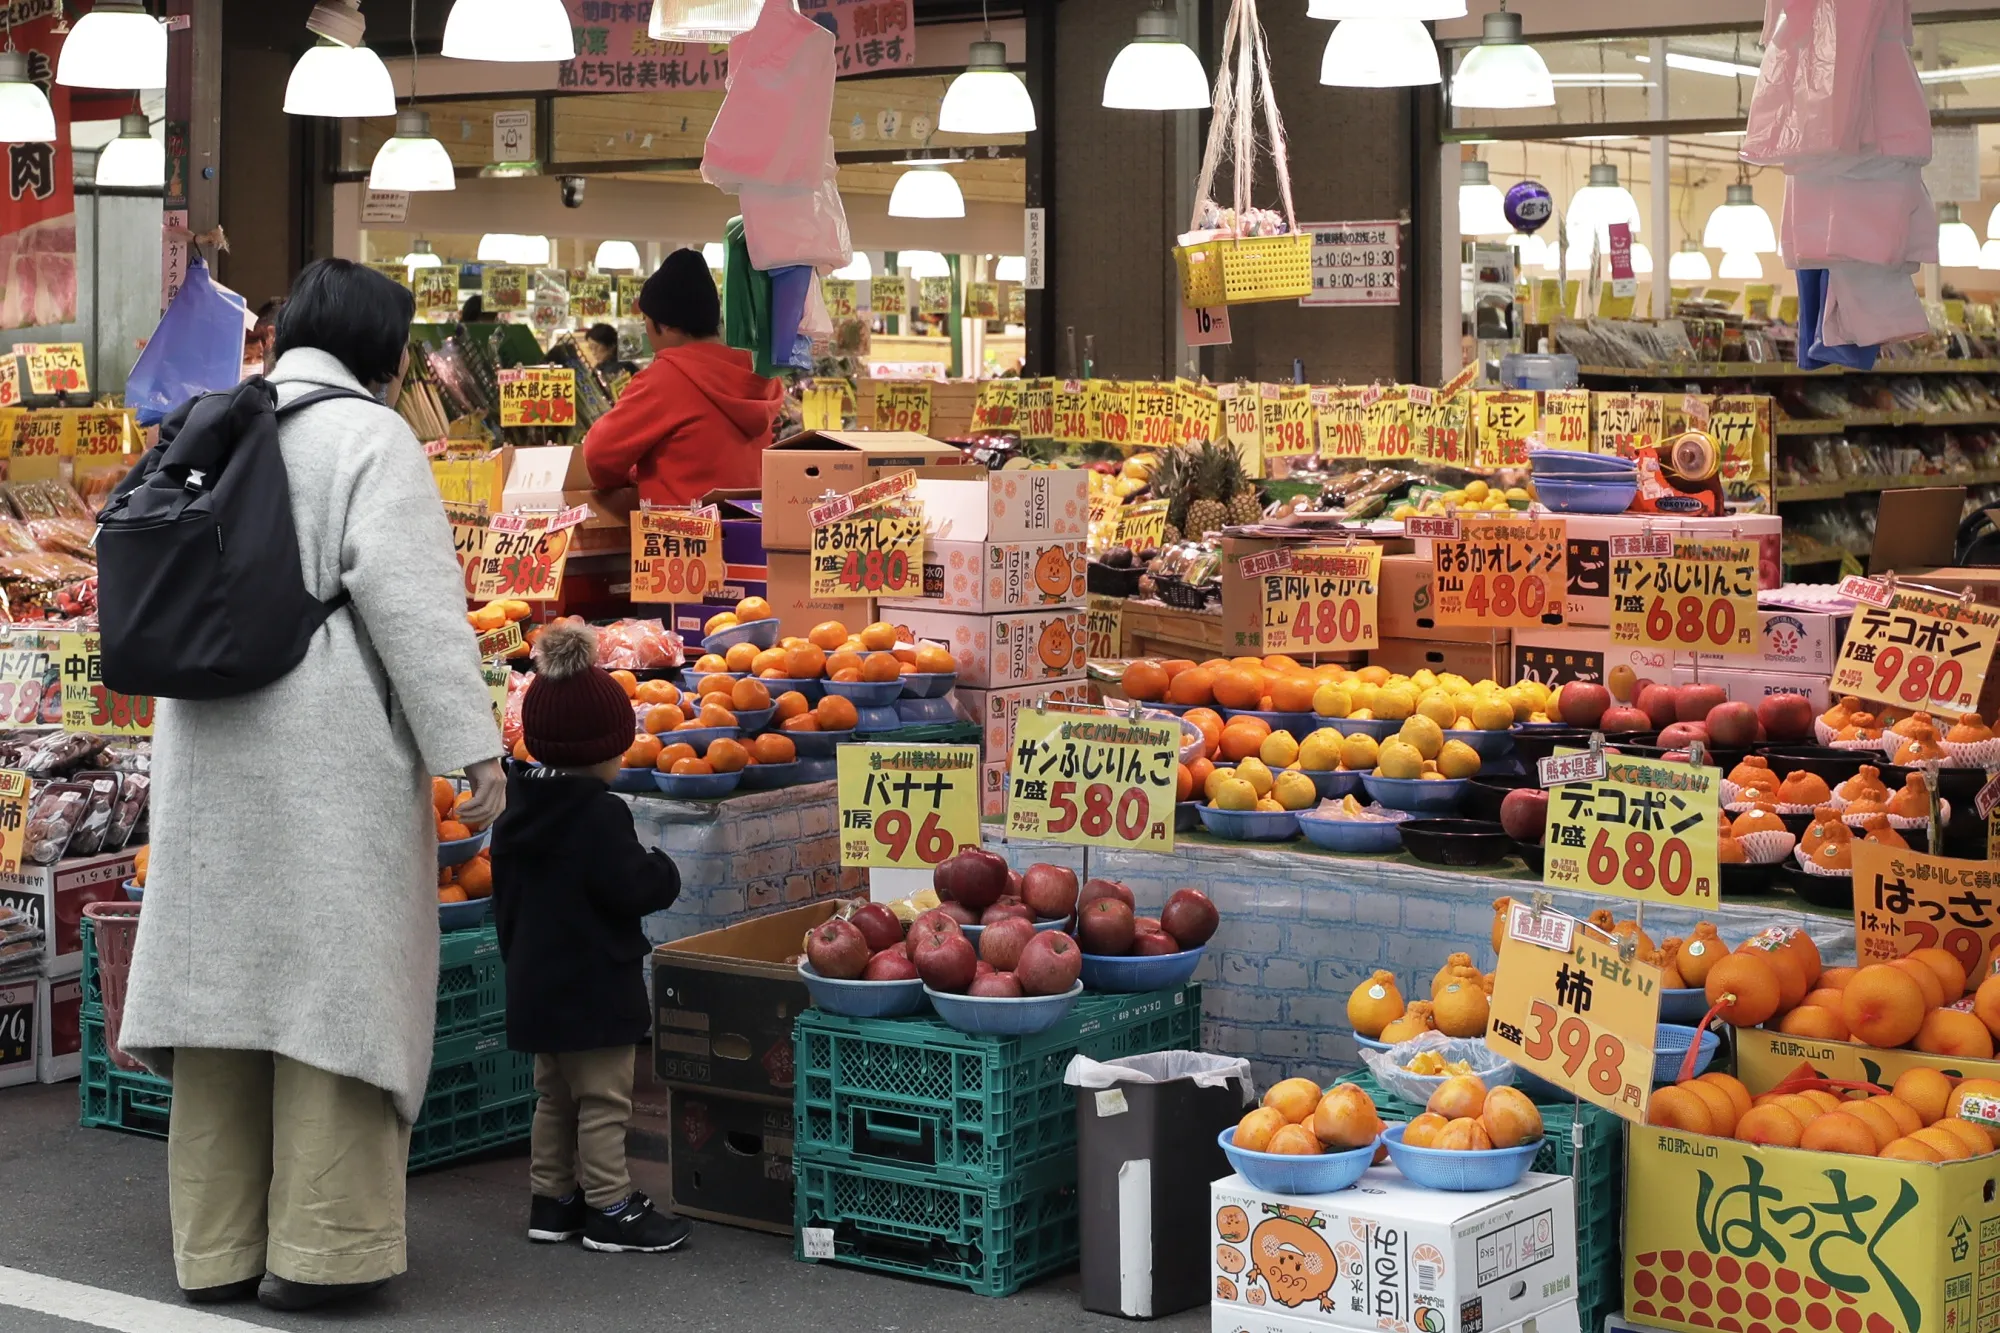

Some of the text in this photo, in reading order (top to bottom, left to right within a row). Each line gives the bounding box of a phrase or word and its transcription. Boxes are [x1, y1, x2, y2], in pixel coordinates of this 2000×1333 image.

[1030, 212, 1039, 286] 防犯カメラ設置店
[1315, 230, 1387, 245] 営業時間のお知らせ
[424, 288, 452, 308] 150
[1195, 308, 1212, 334] 16
[31, 354, 82, 369] だいこん
[503, 381, 573, 400] 桃太郎とまと
[1055, 394, 1088, 412] デコポン
[1091, 392, 1130, 415] サンふじりんご
[1136, 395, 1174, 417] 土佐文旦
[1229, 396, 1256, 413] ライム
[1264, 401, 1310, 424] 完熟パイン
[1368, 402, 1416, 426] キウイフルーツ
[1487, 406, 1526, 428] レモン
[1601, 410, 1662, 434] プレミアムバナナ
[812, 500, 849, 523] 愛媛県産
[1657, 500, 1702, 511] YOKOYAMA
[813, 520, 922, 551] はるみオレンジ
[1115, 515, 1165, 541] 青パパイヤ
[1410, 519, 1455, 537] 熊本県産
[494, 531, 550, 555] みかん
[643, 532, 707, 558] 富有柿
[1613, 536, 1669, 555] 青森県産
[481, 557, 500, 574] 1盛
[634, 559, 651, 574] 1山
[814, 555, 838, 572] 1盛
[1023, 550, 1031, 580] 清水の
[1243, 551, 1290, 575] 愛知県産
[1436, 543, 1563, 574] はるかオレンジ
[1008, 550, 1020, 604] はるみ
[1438, 575, 1465, 593] 1山
[1613, 559, 1755, 598] サンふじりんご
[1614, 594, 1645, 613] 1盛
[1842, 579, 1889, 604] 熊本県産
[1265, 607, 1289, 627] 1山
[1614, 632, 1640, 642] アキダイ
[1861, 608, 1982, 658] デコポン
[1013, 625, 1025, 679] はるみ
[1844, 640, 1879, 664] 1盛
[1835, 677, 1862, 690] アキダイ
[65, 683, 155, 729] 1パック 380
[1017, 739, 1175, 787] サンふじりんご
[1545, 756, 1599, 781] 熊本県産
[862, 771, 954, 810] バナナ
[1014, 778, 1048, 801] 1盛
[843, 808, 873, 829] 1房
[1560, 782, 1705, 836] デコポン
[1011, 822, 1040, 833] アキダイ
[1550, 822, 1587, 849] 1盛
[845, 851, 870, 861] アキダイ
[1549, 869, 1580, 884] アキダイ
[1874, 873, 2000, 929] はっさ
[1517, 911, 1567, 945] 福島県産
[1860, 910, 1902, 937] 1ネット
[1554, 962, 1594, 1015] 柿
[1492, 1017, 1524, 1047] 1盛
[1770, 1039, 1836, 1061] 和歌山の
[1658, 1135, 1719, 1160] 和歌山の
[1479, 1246, 1495, 1259] 5kg
[1696, 1155, 1923, 1333] はっさく
[1950, 1231, 1970, 1263] 西
[1373, 1225, 1399, 1320] はるみ
[1349, 1261, 1364, 1313] 清水の
[1946, 1307, 1957, 1331] 秀
